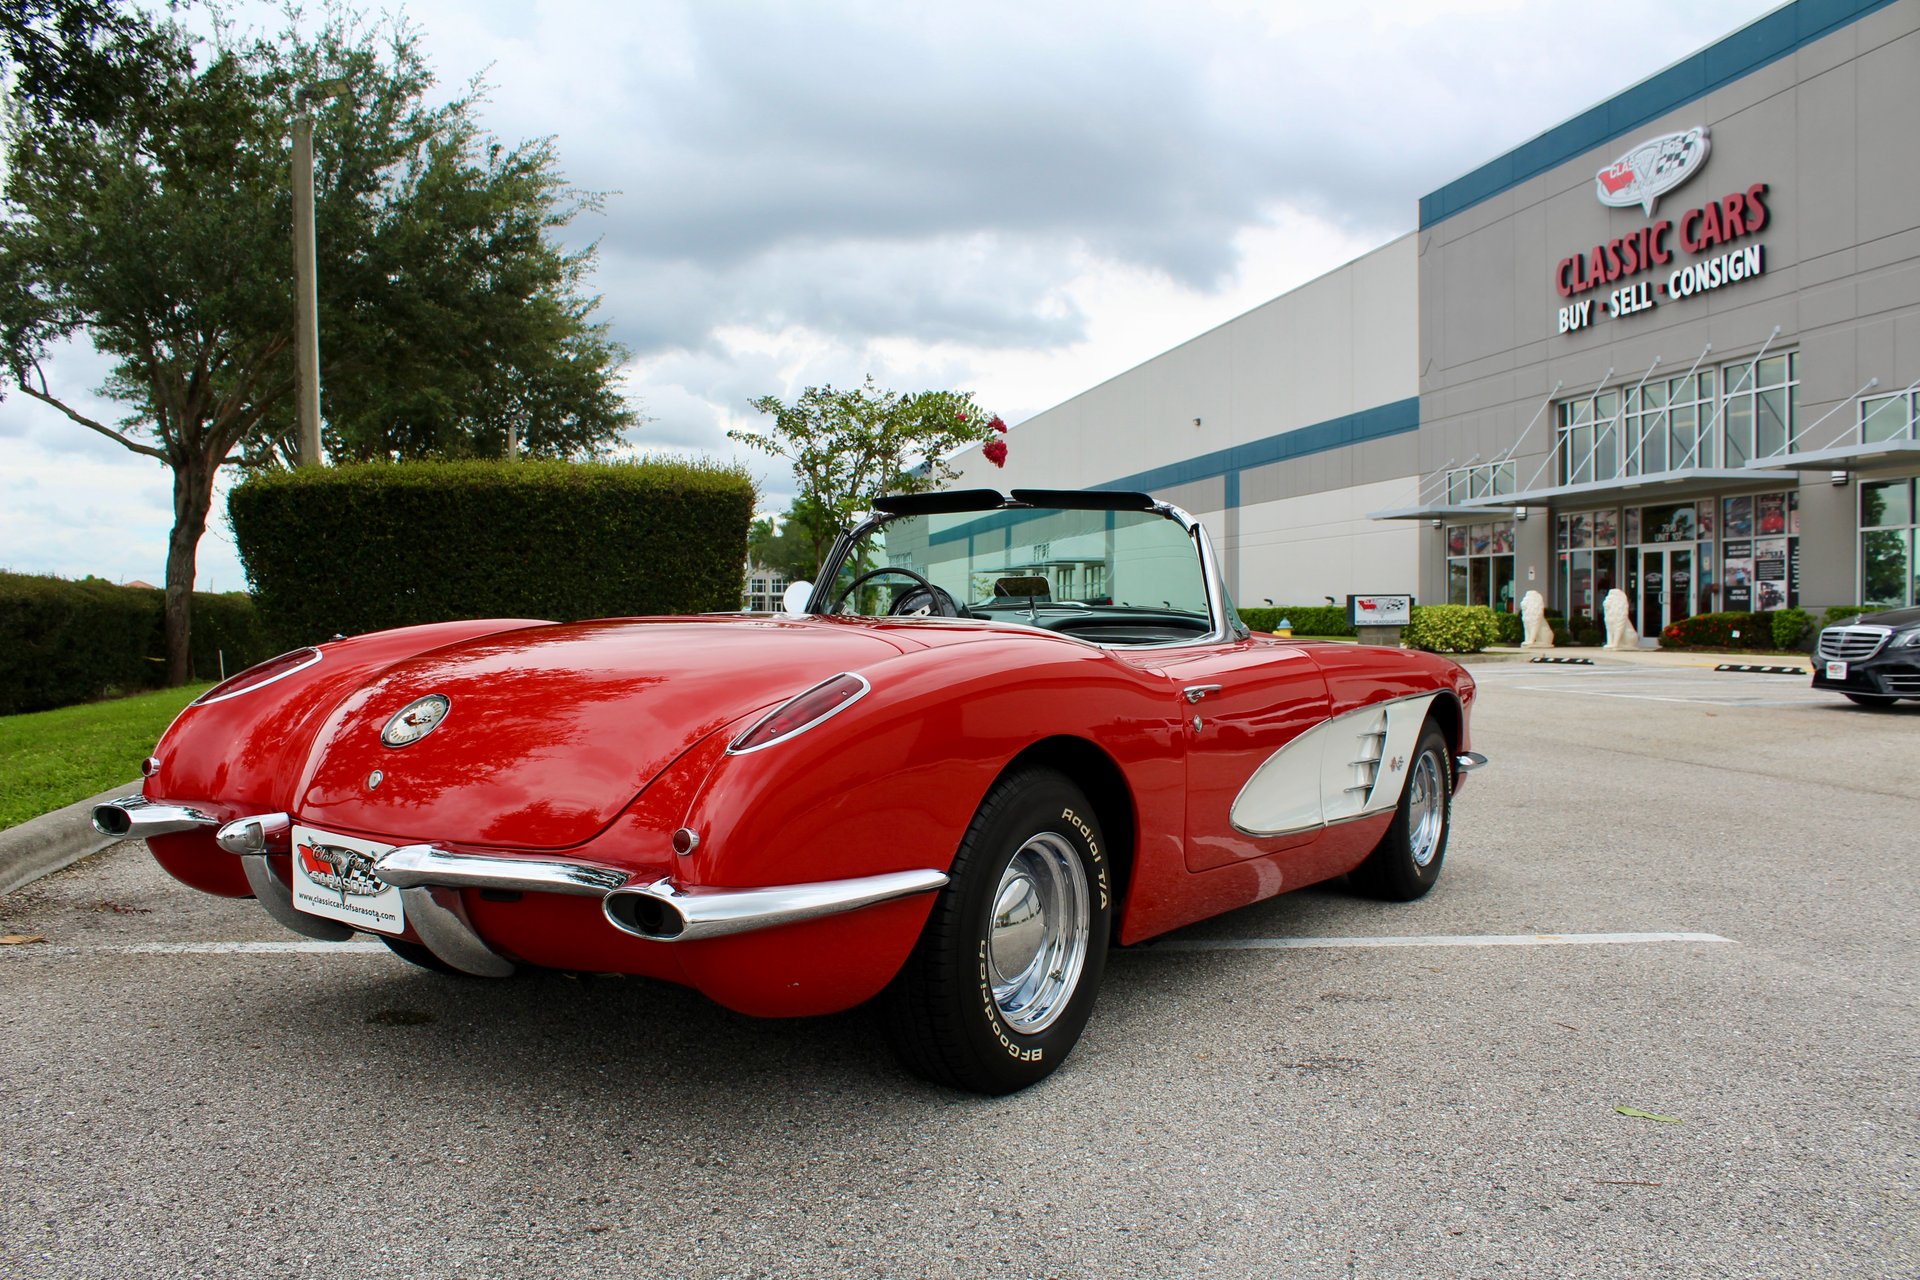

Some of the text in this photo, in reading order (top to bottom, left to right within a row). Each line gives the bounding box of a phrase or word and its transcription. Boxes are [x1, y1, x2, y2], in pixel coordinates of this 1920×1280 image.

[1555, 182, 1766, 298] CLASSIC CARS
[1558, 243, 1762, 335] BUY SELL CONSIGN
[310, 870, 376, 898] SARASOTA
[311, 843, 371, 871] Classic Cars
[1061, 808, 1108, 911] Radial T/A
[299, 891, 396, 921] www.classiccarsofsarasota.com
[979, 940, 1043, 1061] BFGoodrich
